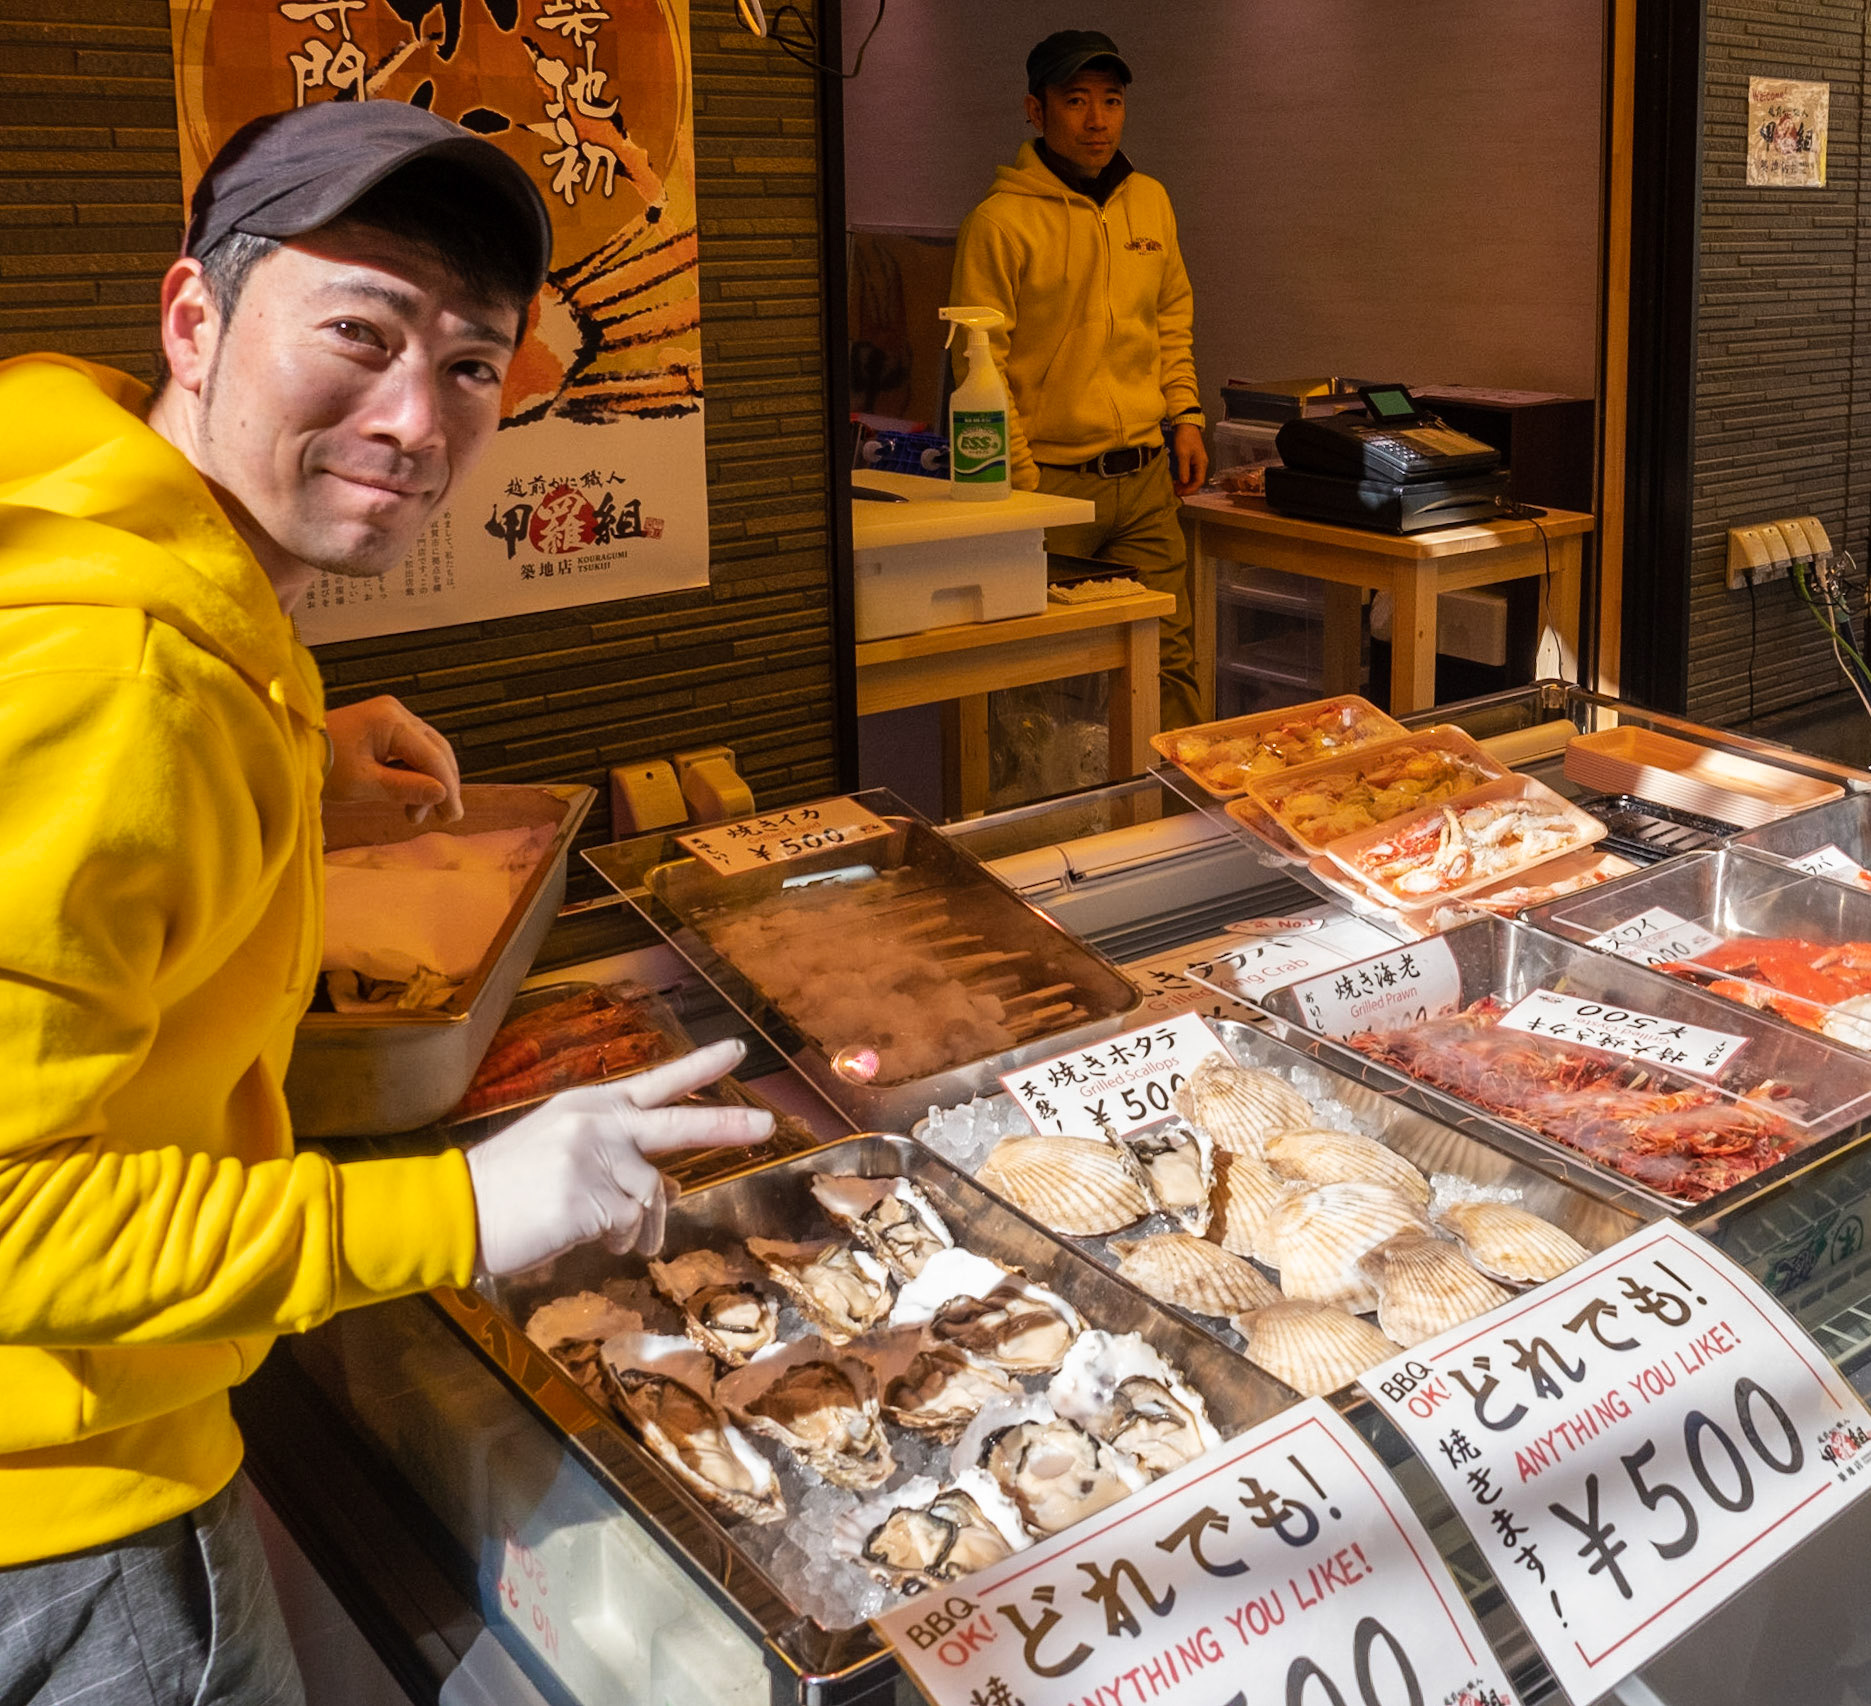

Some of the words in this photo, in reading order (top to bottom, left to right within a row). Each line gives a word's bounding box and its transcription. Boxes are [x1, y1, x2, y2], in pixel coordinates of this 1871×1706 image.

[504, 469, 626, 498] 越前かに職人
[484, 492, 648, 560] 甲羅組
[521, 559, 573, 581] 築地店
[577, 551, 628, 565] KOURAGUMI
[577, 561, 611, 574] TSUKIJI
[727, 808, 820, 839] 焼きイカ
[747, 827, 845, 862] ¥500
[1262, 959, 1309, 978] Crab
[1335, 953, 1421, 1000] 焼き海老
[1304, 991, 1327, 1035] おいし
[1350, 994, 1384, 1018] Grilled
[1385, 987, 1418, 1006] Prawn
[1576, 1005, 1688, 1039] ¥500
[1047, 1028, 1178, 1088] 焼きホタテ
[1527, 1017, 1688, 1064] 特大焼きカキ
[1079, 1073, 1125, 1098] Grilled
[1127, 1055, 1180, 1081] Scallops
[1018, 1080, 1063, 1133] 天然!
[1447, 1260, 1708, 1432] どれでも!
[1381, 1361, 1434, 1404] BBQ
[1408, 1376, 1453, 1419] OK!
[1514, 1389, 1632, 1483] ANYTHING
[1630, 1359, 1677, 1406] YOU
[1684, 1321, 1742, 1375] LIKE!
[1548, 1376, 1805, 1601] ¥500
[1439, 1428, 1569, 1629] 焼きます!
[997, 1454, 1343, 1679] どれでも!
[1225, 1588, 1287, 1647] YOU
[1298, 1542, 1375, 1612] LIKE!
[905, 1596, 981, 1651] BBQ
[937, 1613, 998, 1668] OK!
